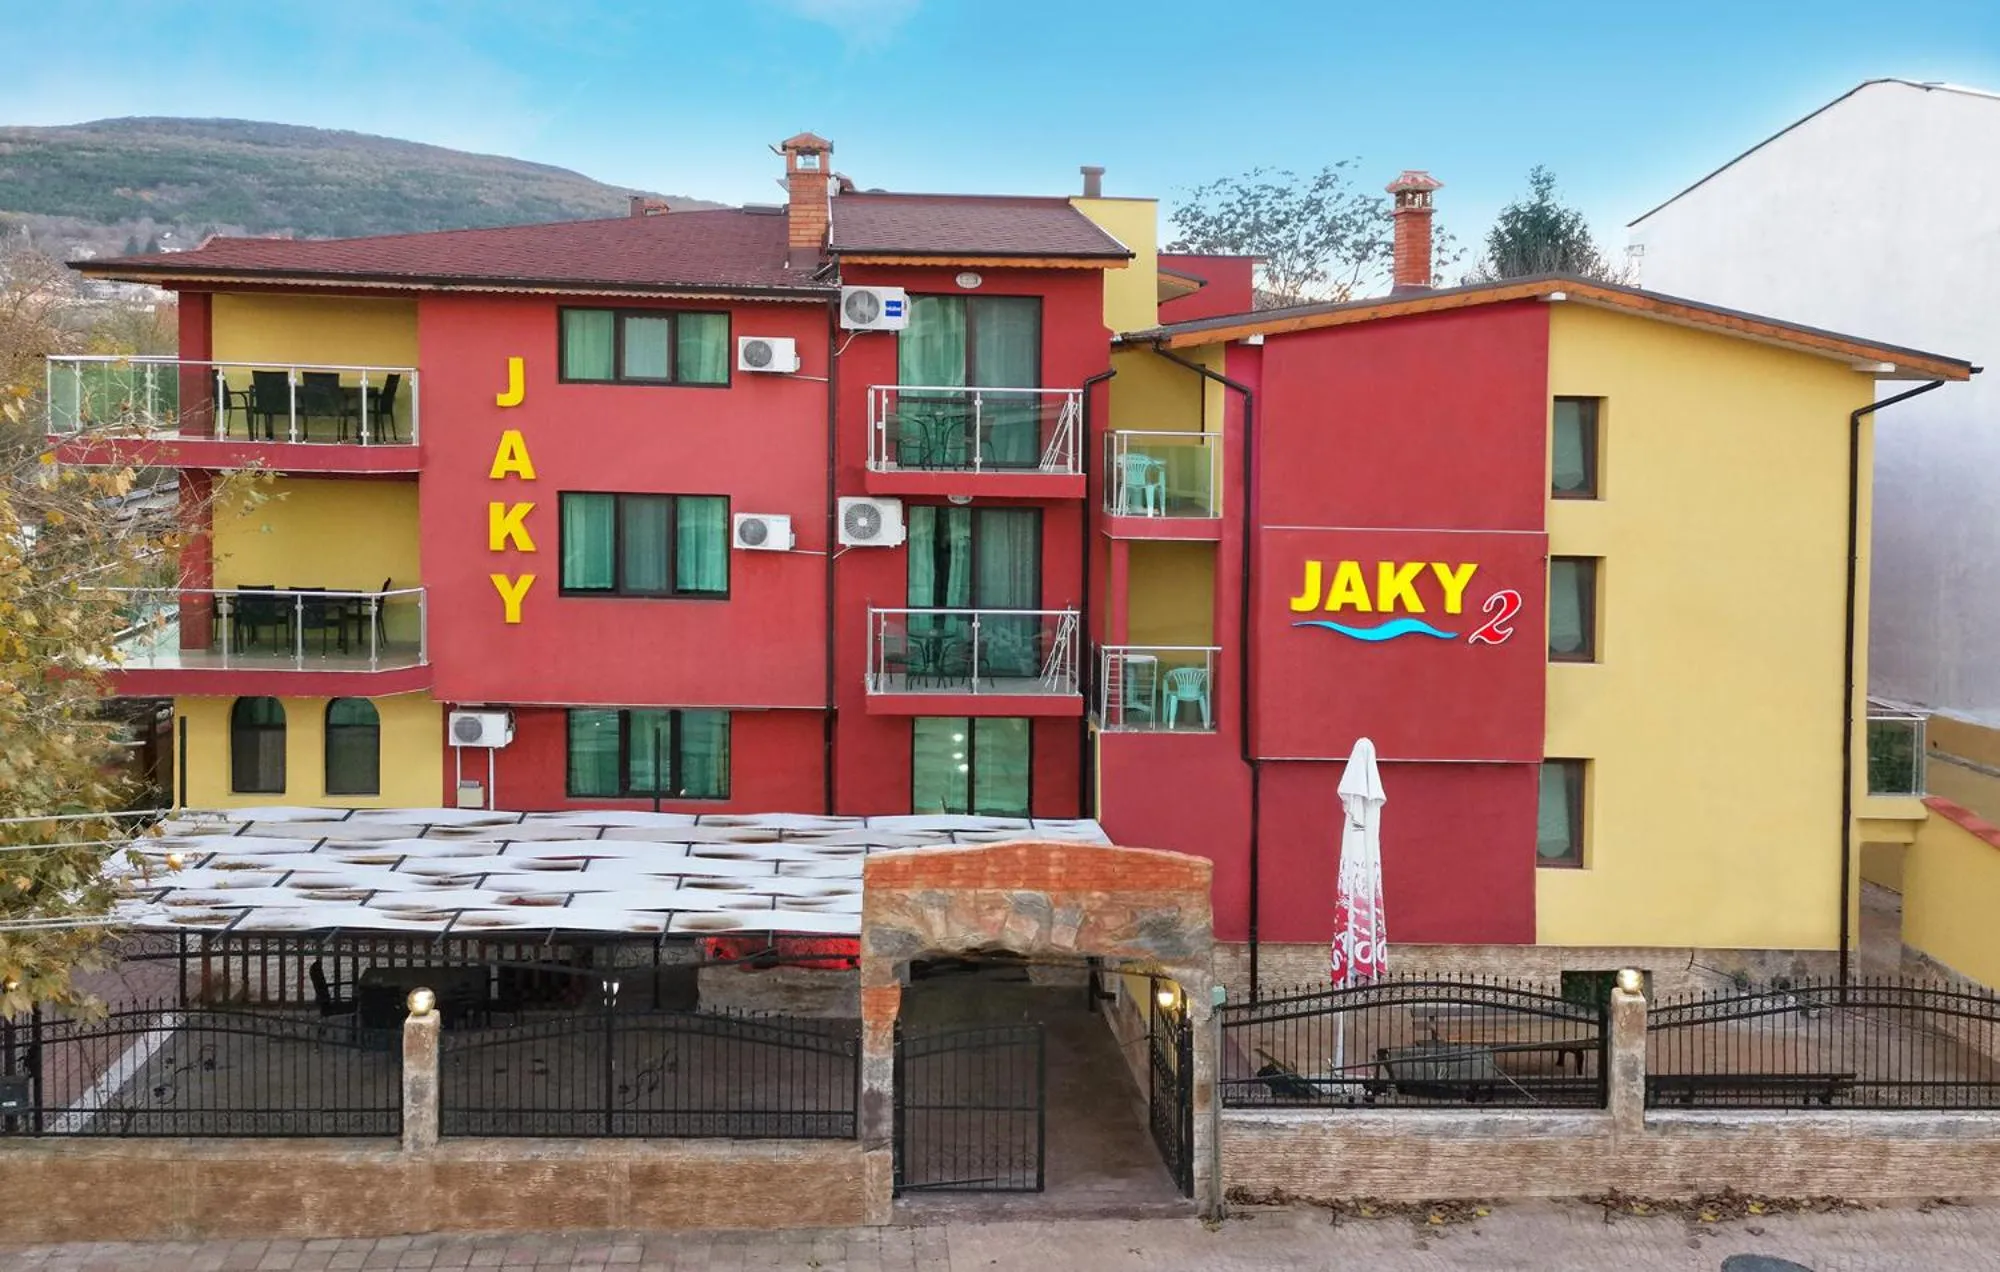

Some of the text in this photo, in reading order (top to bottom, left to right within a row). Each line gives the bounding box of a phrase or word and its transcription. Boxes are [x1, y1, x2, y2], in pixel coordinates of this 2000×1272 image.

[489, 356, 537, 623] JAKY
[1289, 560, 1522, 645] JAKY 2
